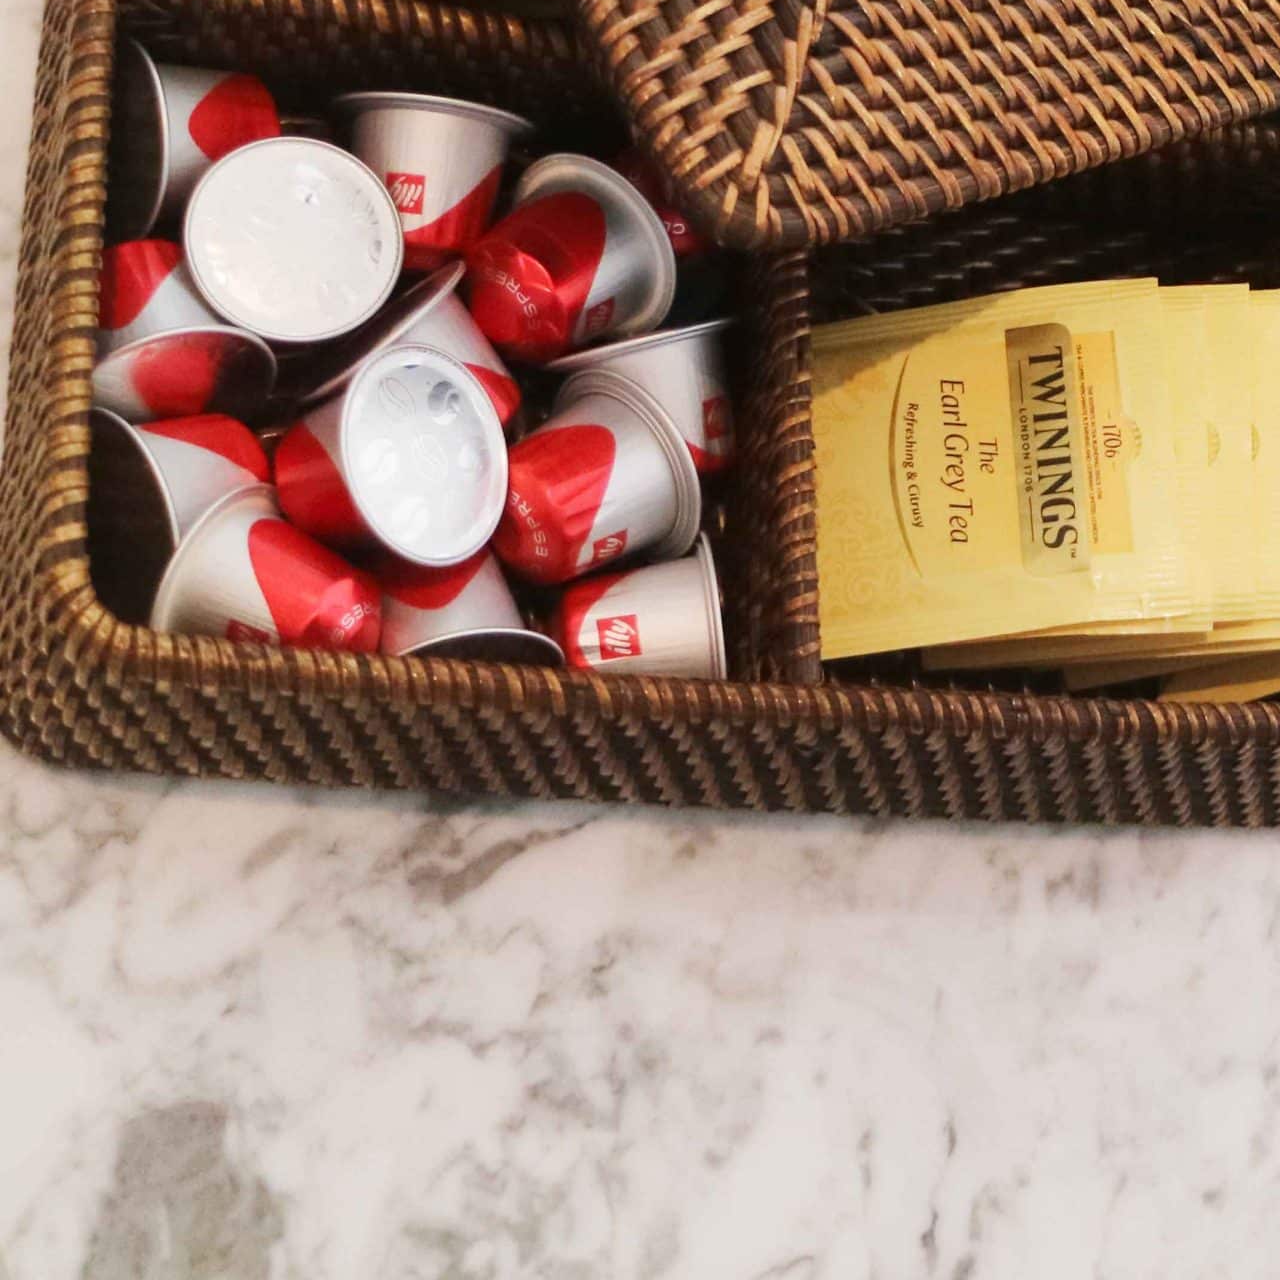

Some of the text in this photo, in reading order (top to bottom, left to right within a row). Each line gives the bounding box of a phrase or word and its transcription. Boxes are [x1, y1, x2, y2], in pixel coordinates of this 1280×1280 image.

[390, 176, 423, 208] illy
[978, 437, 999, 475] The
[1018, 407, 1034, 493] LONDON 1706
[1101, 423, 1122, 459] 1706
[902, 402, 925, 528] Refreshing & Citrusy
[940, 379, 974, 543] Earl Grey Tea
[604, 618, 637, 655] illy
